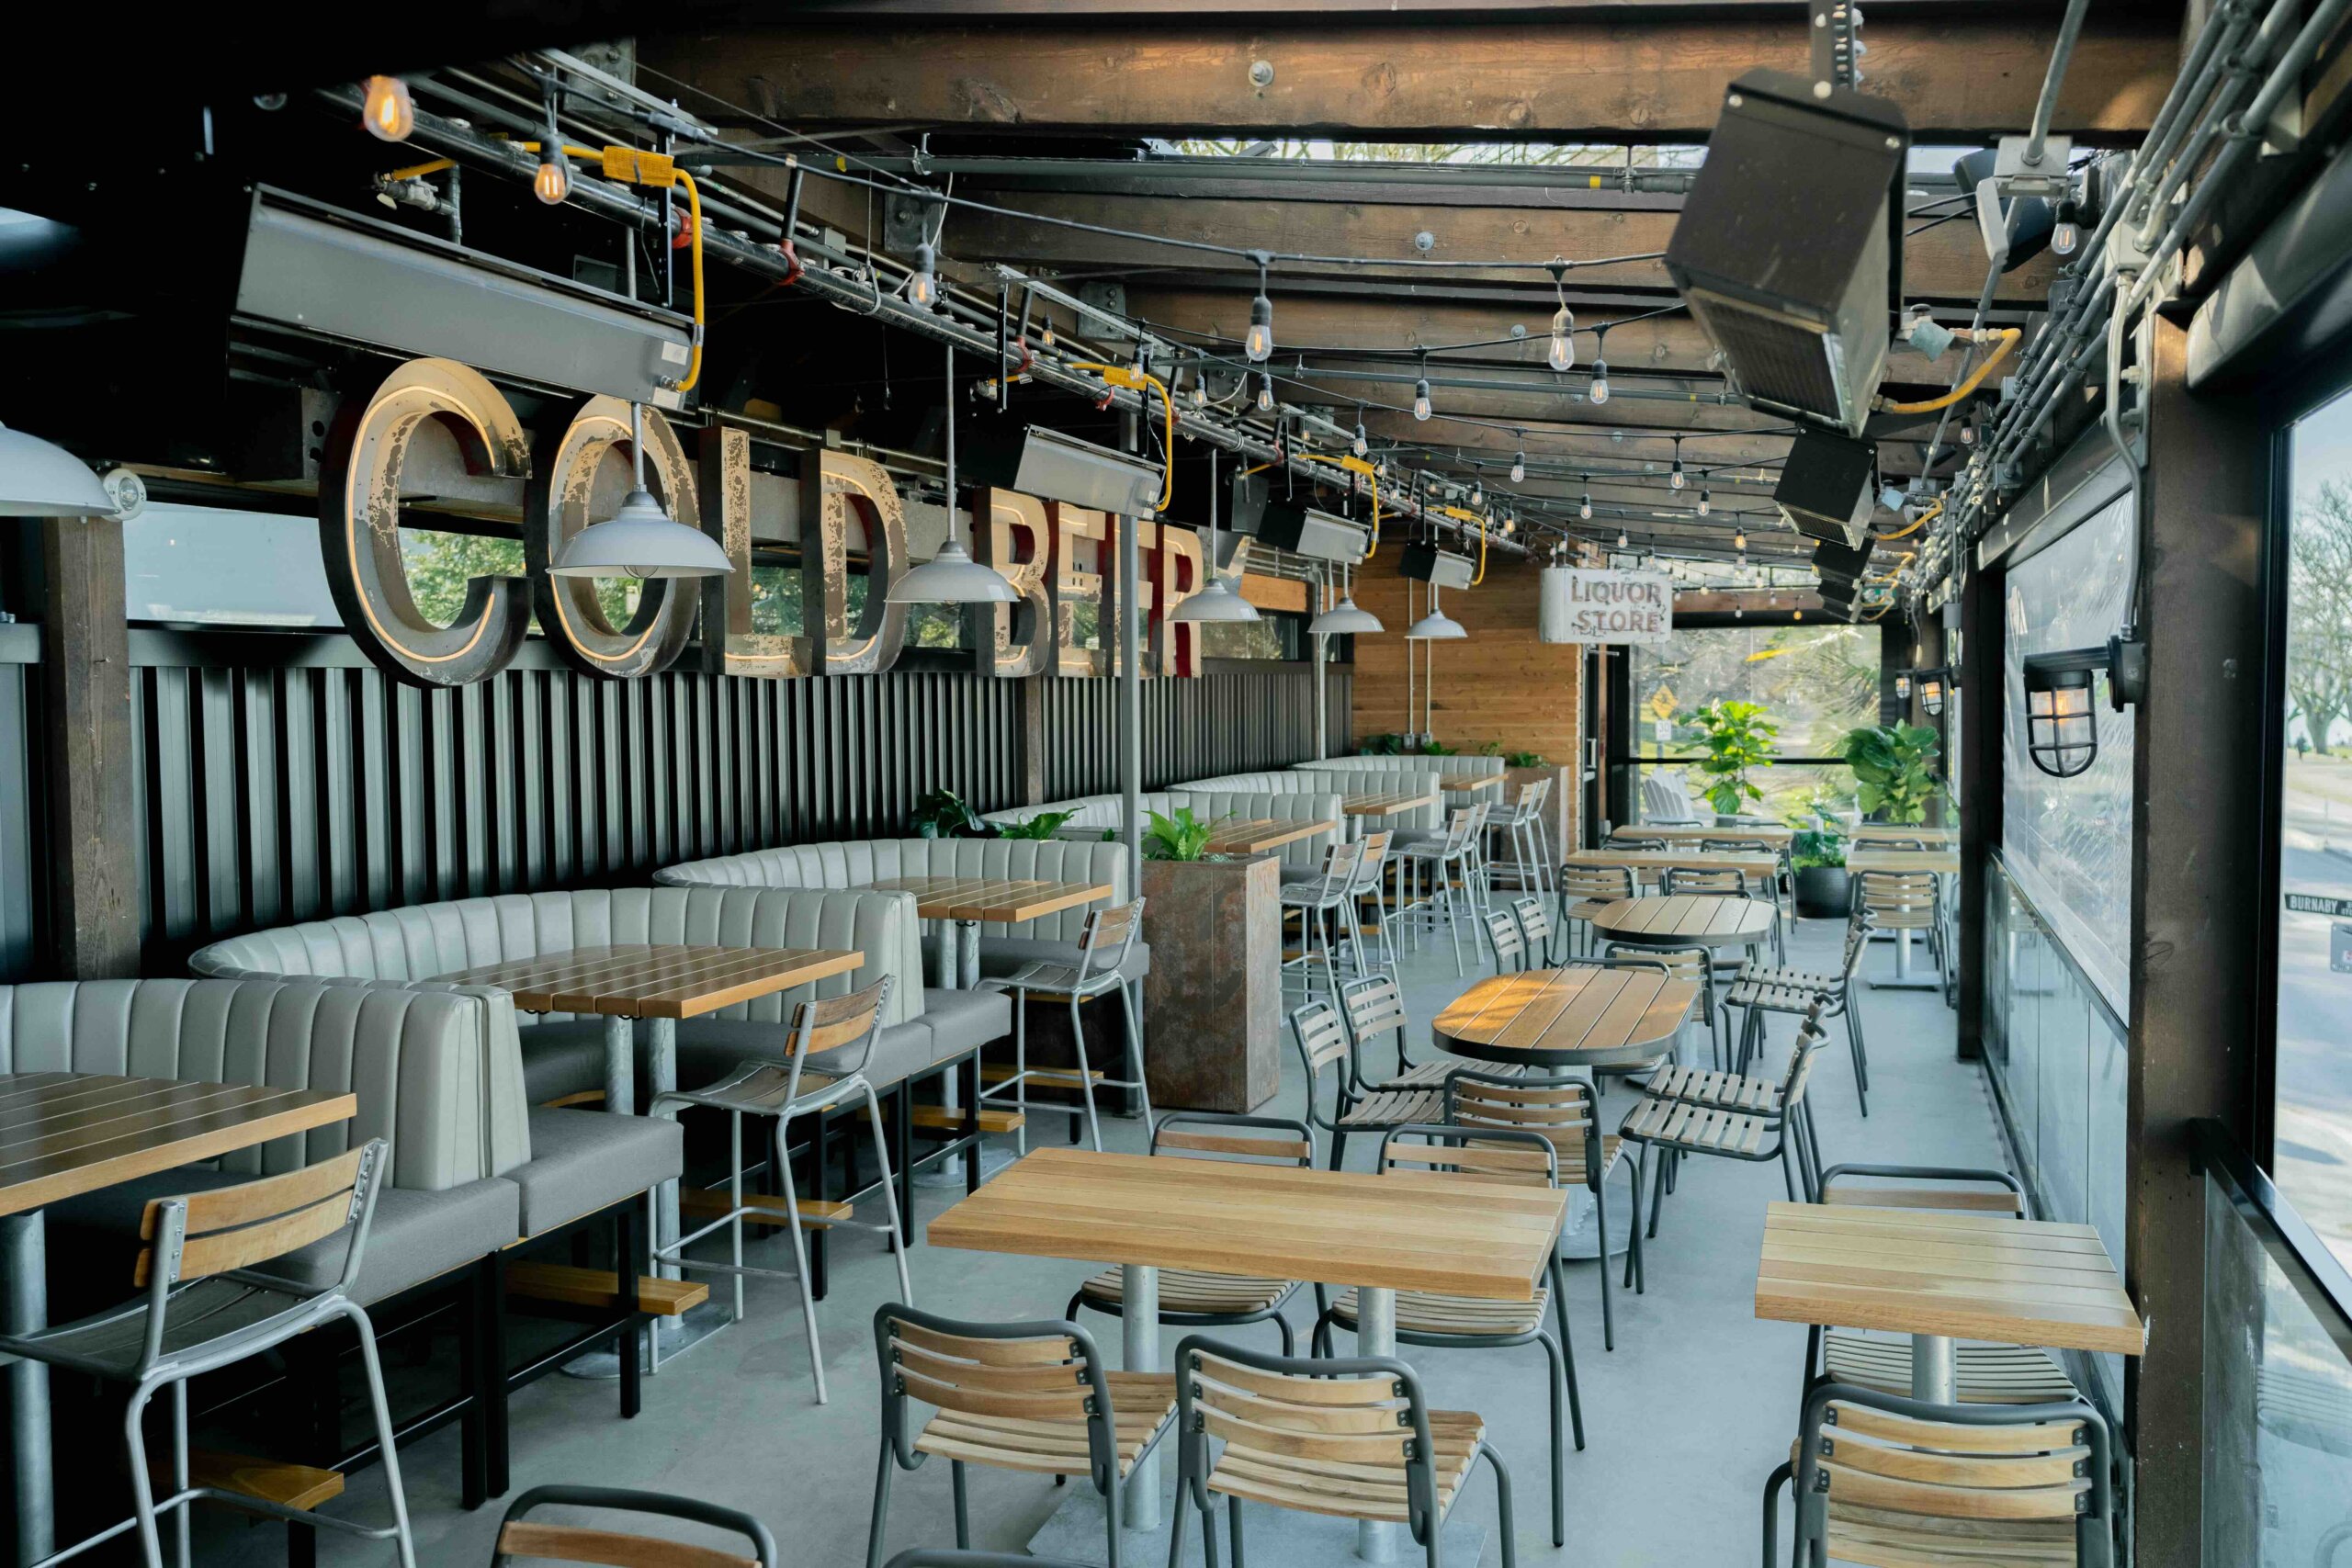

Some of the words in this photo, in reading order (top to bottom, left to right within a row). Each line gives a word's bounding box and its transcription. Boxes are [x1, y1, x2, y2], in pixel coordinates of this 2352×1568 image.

[320, 358, 909, 688] COLD
[972, 485, 1204, 680] BEER
[1571, 578, 1661, 603] LIQUOR
[1577, 610, 1660, 633] STORE
[2290, 896, 2337, 914] BURNABY
